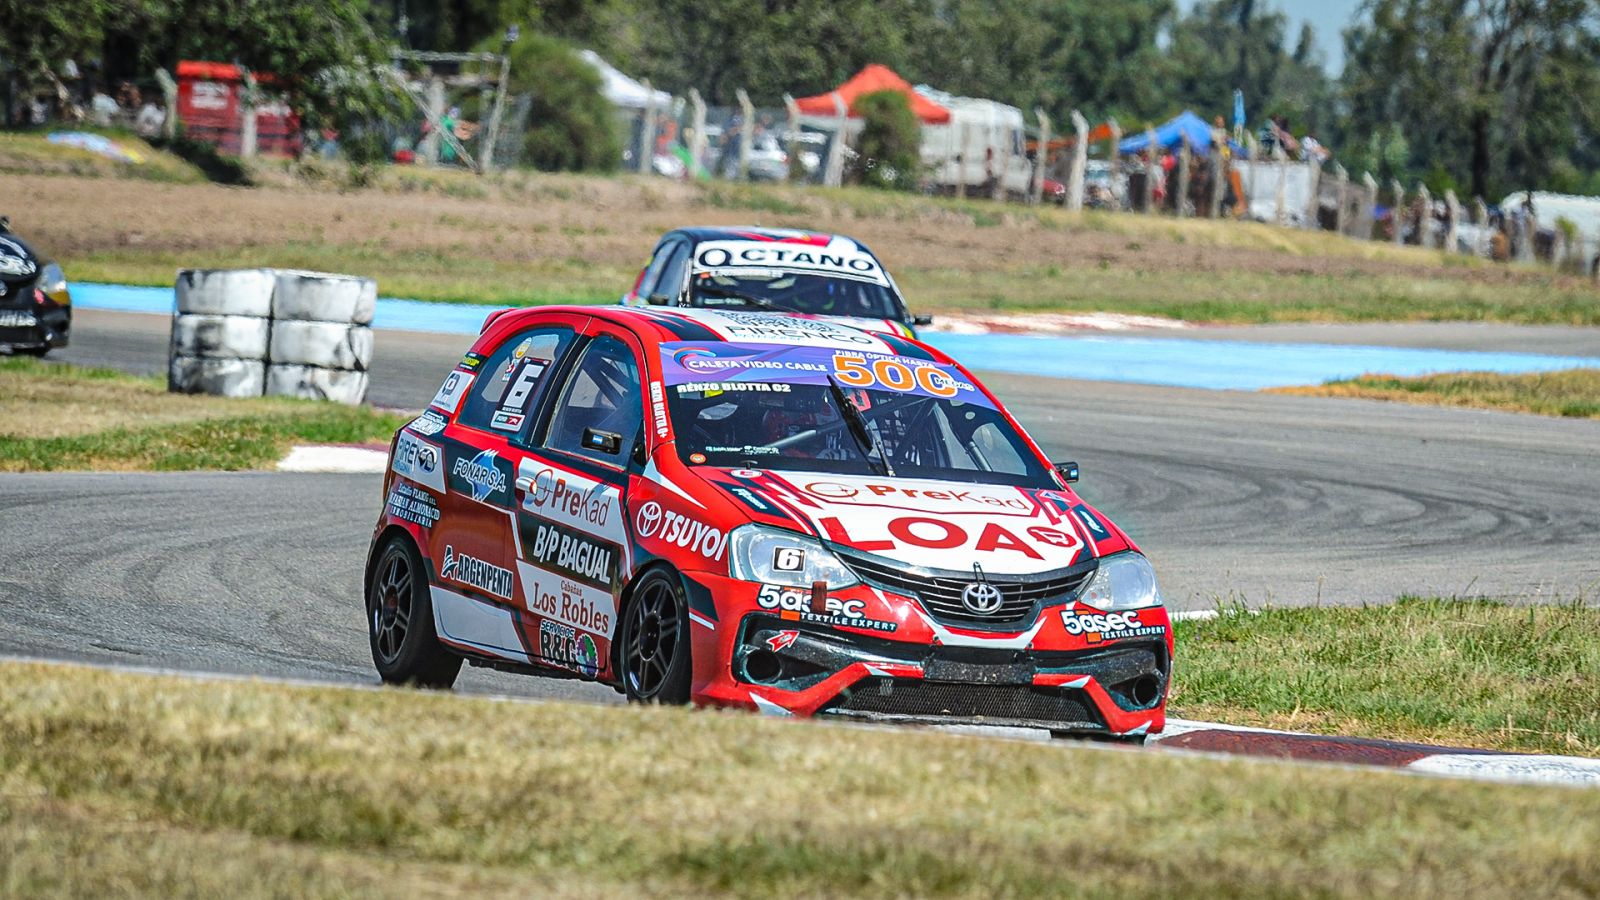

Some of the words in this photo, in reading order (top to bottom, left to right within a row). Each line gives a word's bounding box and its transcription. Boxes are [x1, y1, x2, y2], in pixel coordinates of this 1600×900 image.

[699, 249, 874, 271] OCTANO
[725, 326, 872, 344] PIRENCO
[688, 360, 740, 369] CALETA
[739, 361, 783, 369] VIDEO
[786, 361, 828, 372] CABLE
[504, 363, 544, 408] 6
[721, 382, 772, 392] BLOTTA
[454, 457, 488, 486] FONAR
[487, 470, 507, 493] S.A.
[551, 478, 611, 527] PreKad
[865, 485, 1030, 511] PreKad
[818, 516, 1046, 561] LOA
[533, 525, 560, 562] B/P
[557, 534, 611, 584] BAGUAL
[777, 548, 801, 570] 6
[456, 553, 513, 600] ARGENPENTA
[533, 582, 557, 615] Los
[560, 592, 609, 633] Robles
[801, 612, 848, 625] TEXTILE
[851, 618, 897, 631] EXPERT
[1060, 610, 1142, 635] 5asec
[1101, 628, 1134, 639] TEXTILE
[1135, 625, 1166, 636] EXPERT
